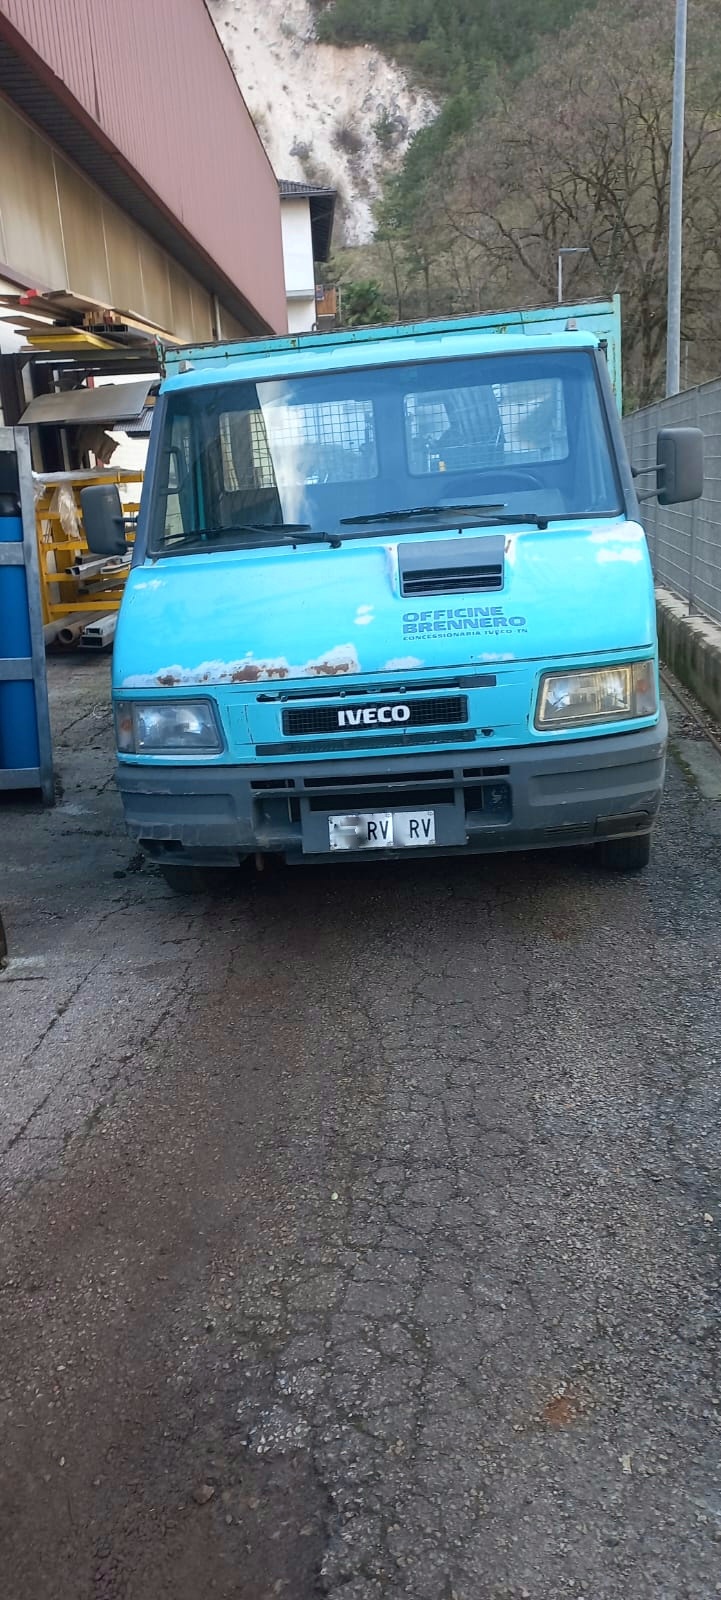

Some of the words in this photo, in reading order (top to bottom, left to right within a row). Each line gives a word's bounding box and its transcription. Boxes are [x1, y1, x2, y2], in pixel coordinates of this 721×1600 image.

[402, 606, 504, 622] OFFICINE
[402, 616, 526, 634] BRENNERO
[403, 631, 481, 641] CONCESSIONARIA
[337, 705, 411, 726] IVECO
[367, 821, 389, 841] RV
[409, 818, 431, 839] RV
